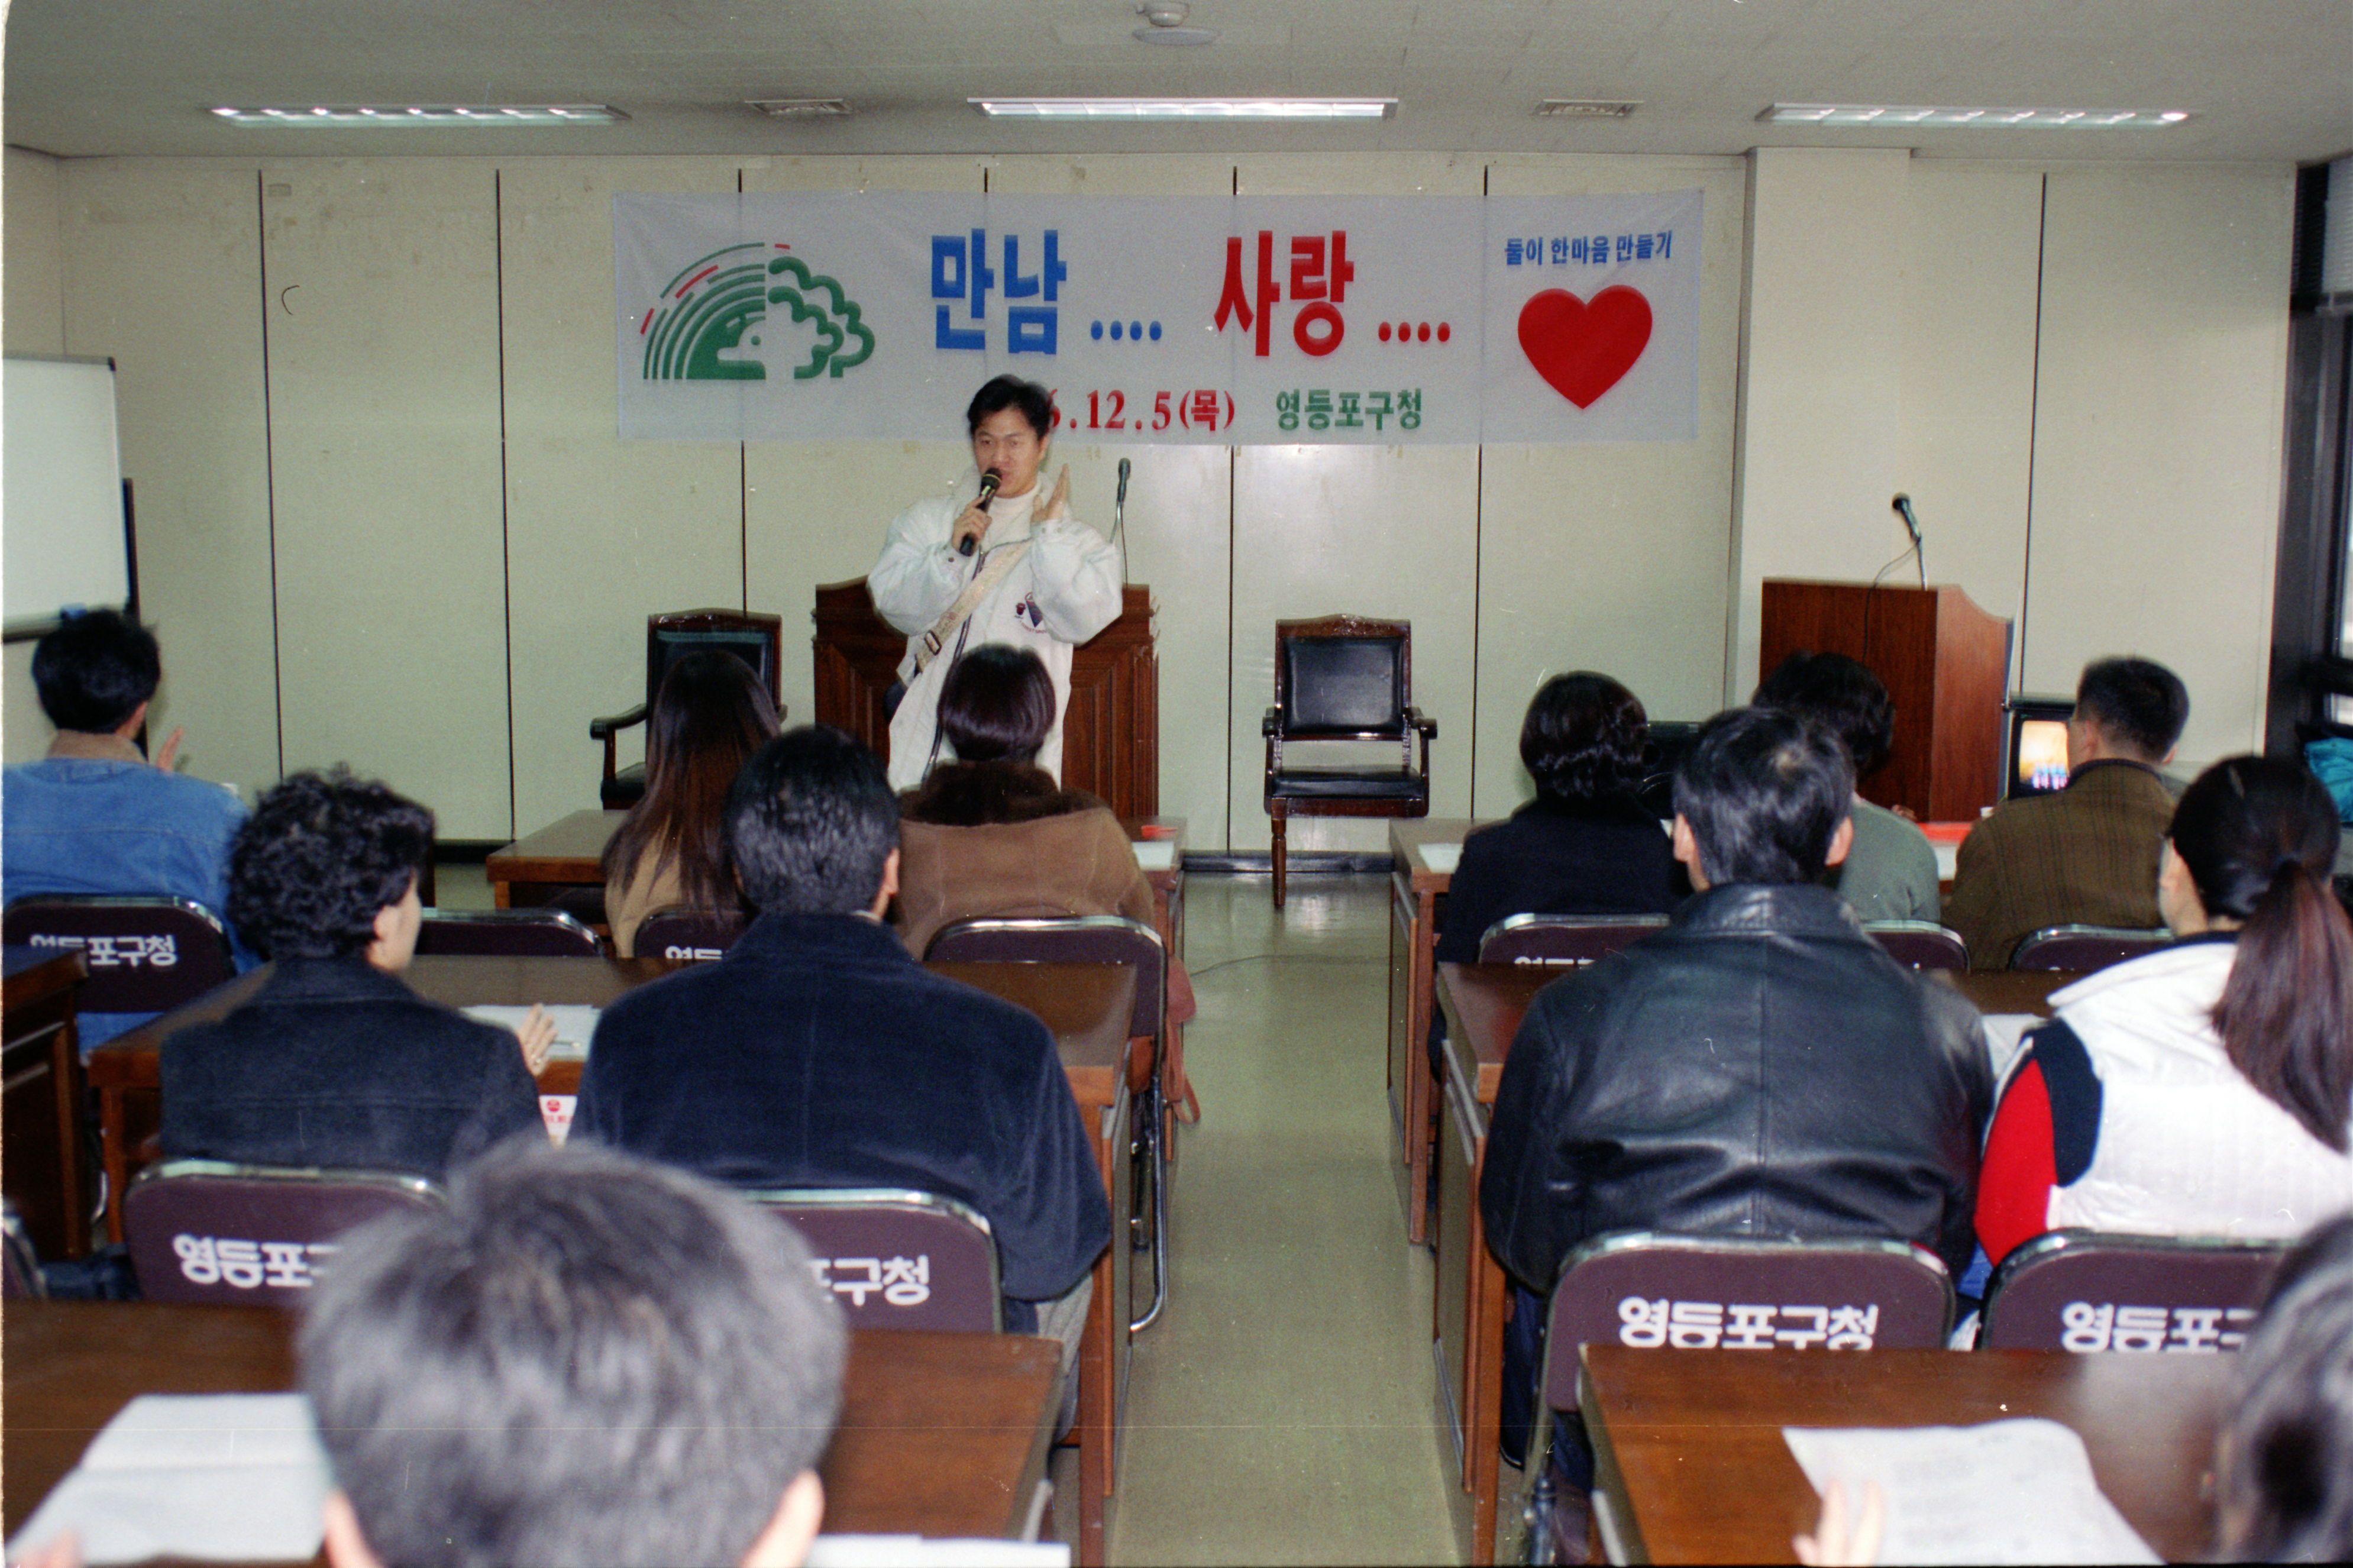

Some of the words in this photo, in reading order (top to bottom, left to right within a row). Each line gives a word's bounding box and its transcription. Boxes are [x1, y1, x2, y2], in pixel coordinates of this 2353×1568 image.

[1505, 237, 1543, 266] 둘이
[1551, 236, 1610, 264] 한마음
[1617, 229, 1672, 263] 만들기
[1276, 389, 1423, 431] 영등포구청
[1618, 1296, 1879, 1350] 영등포구청
